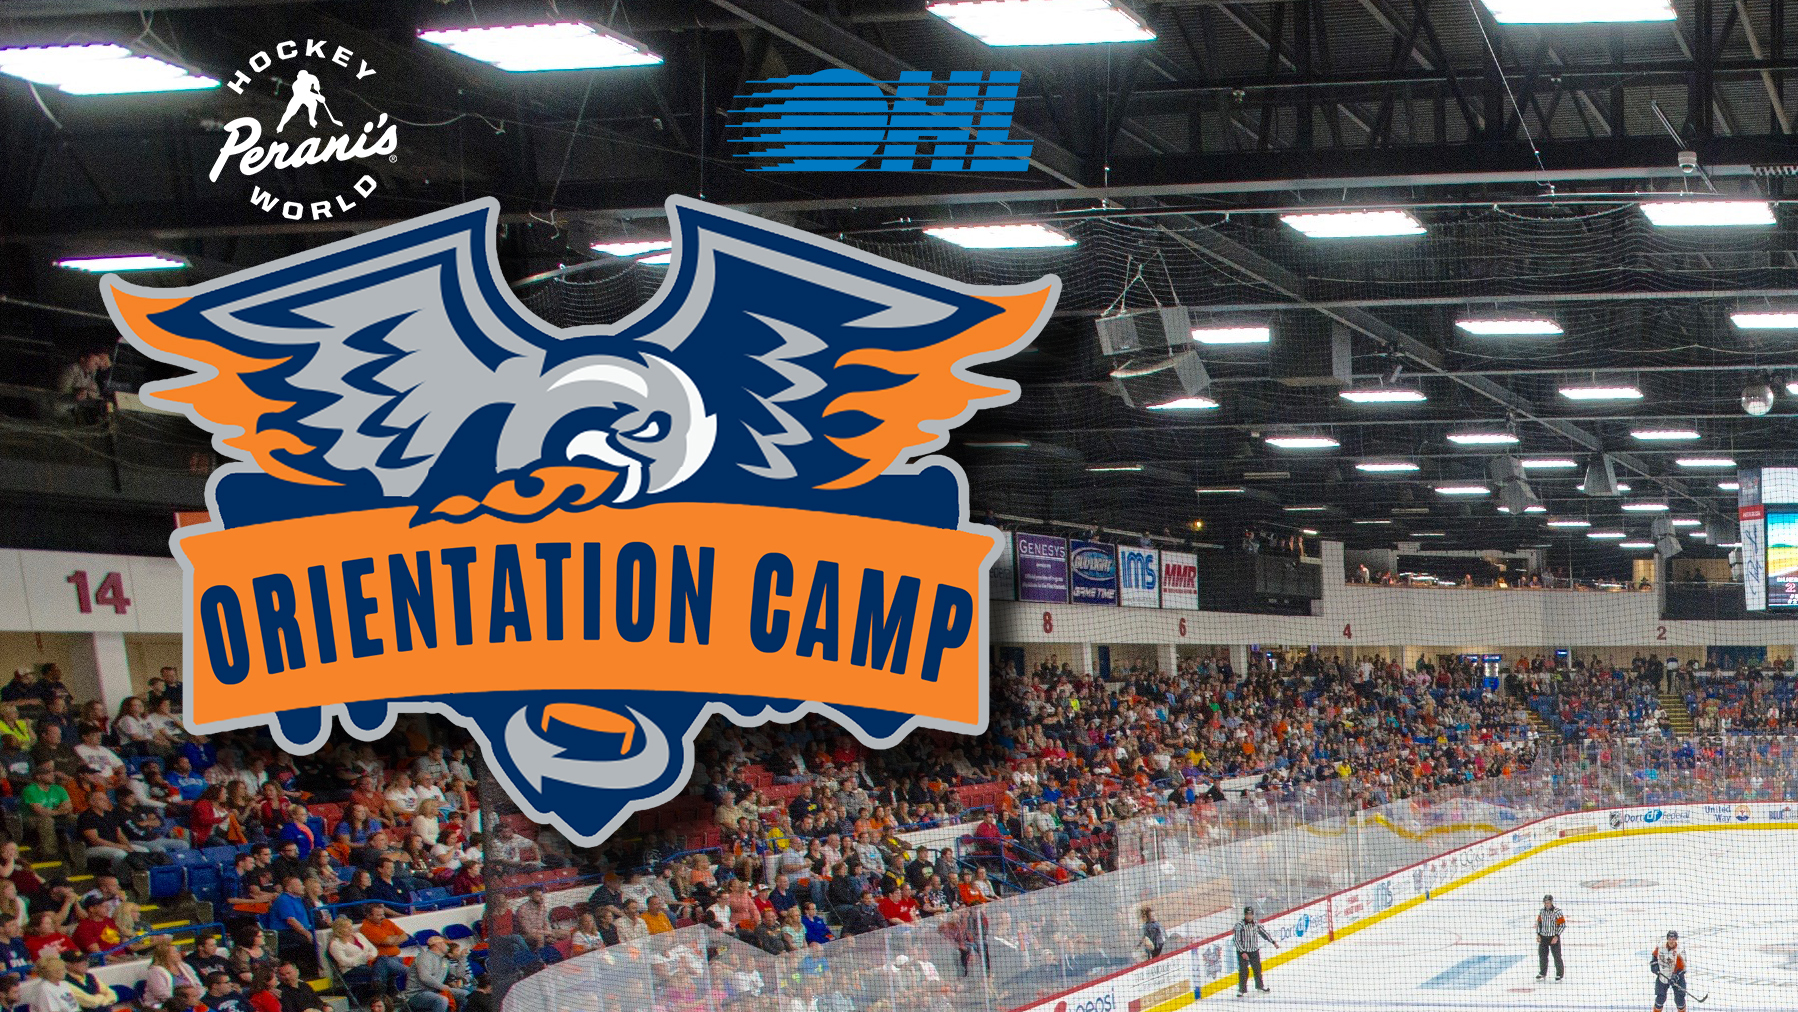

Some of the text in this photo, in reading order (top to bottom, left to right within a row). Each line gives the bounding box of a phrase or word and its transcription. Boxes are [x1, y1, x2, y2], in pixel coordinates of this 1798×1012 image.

[1019, 538, 1067, 560] GENESYS
[1164, 563, 1197, 588] MMR
[68, 570, 132, 616] 14
[1785, 583, 1796, 592] 2
[1043, 612, 1053, 634] 8
[1179, 618, 1187, 637] 6
[1343, 624, 1352, 639] 4
[1656, 626, 1667, 641] 2
[1624, 813, 1643, 823] Dort
[1662, 809, 1690, 819] Federal
[1704, 804, 1731, 813] United
[1769, 811, 1784, 820] BLUE
[1714, 813, 1731, 823] Way
